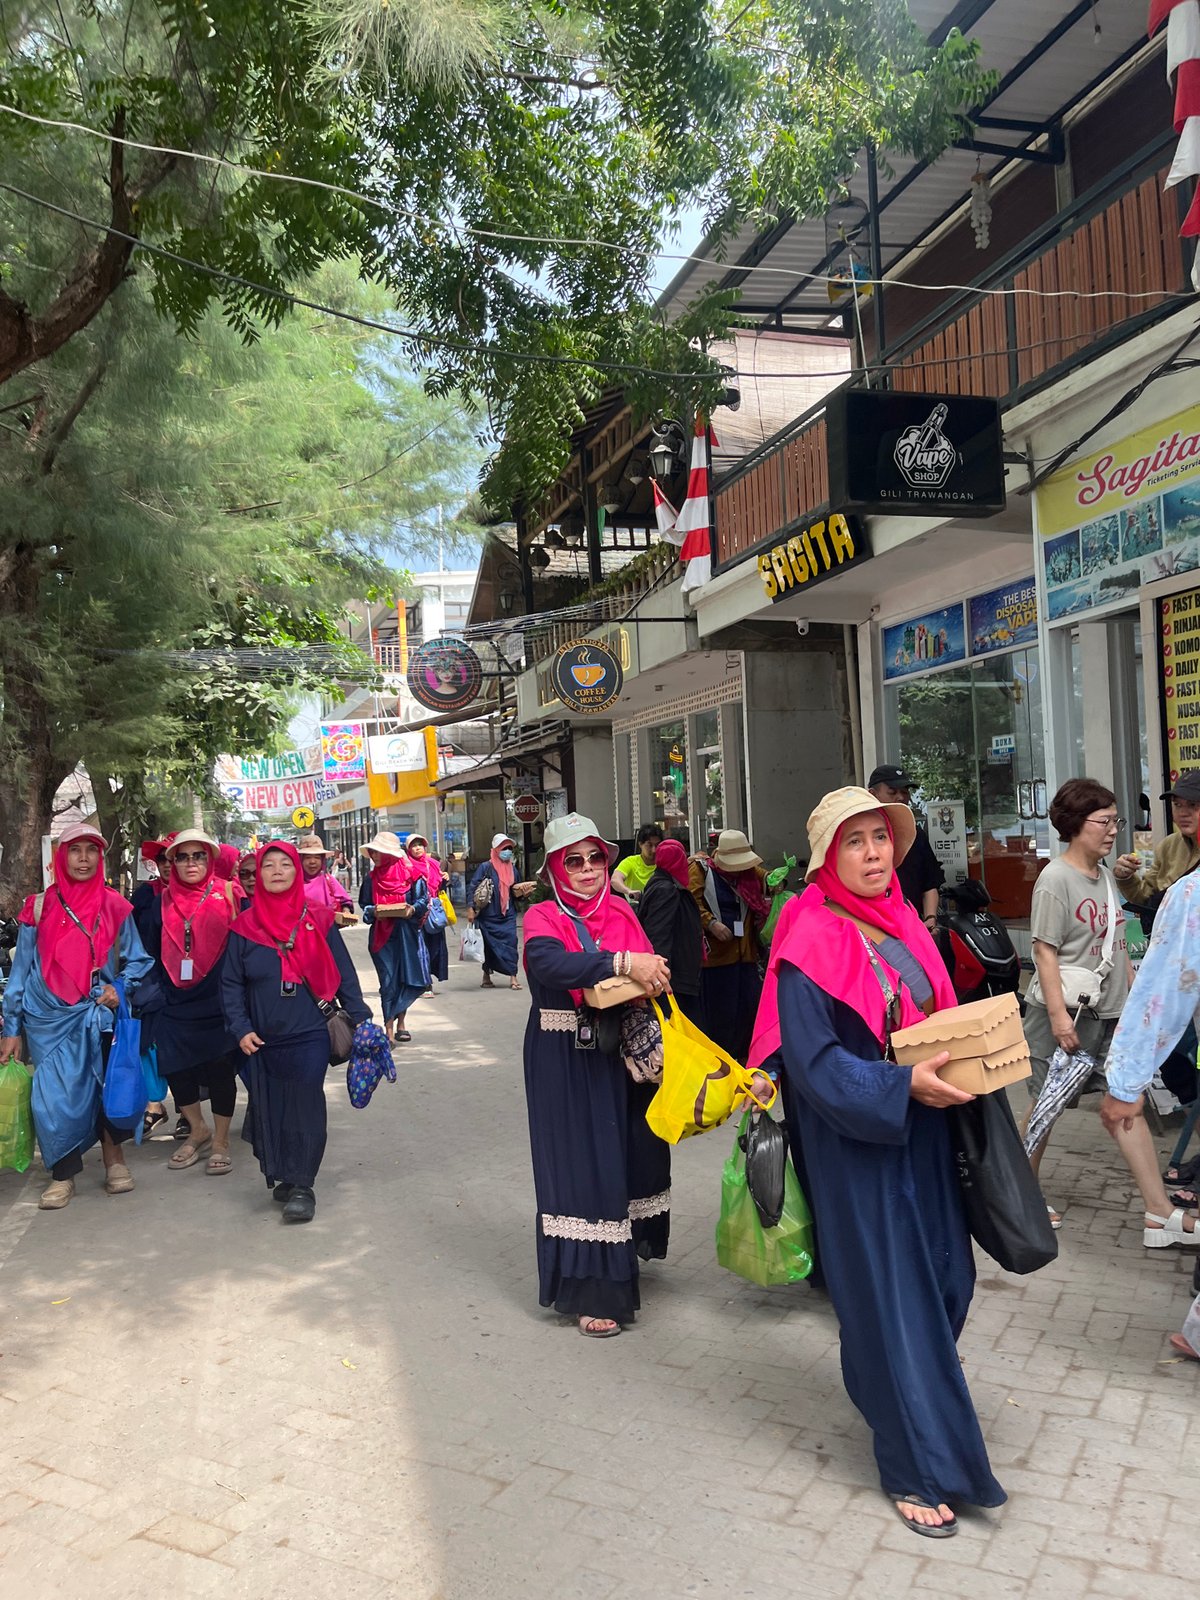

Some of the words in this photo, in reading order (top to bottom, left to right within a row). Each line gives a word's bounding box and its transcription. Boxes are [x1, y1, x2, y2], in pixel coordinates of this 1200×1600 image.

[900, 442, 953, 470] Vape
[914, 472, 940, 480] SHOP
[1147, 468, 1179, 486] Ticketing
[880, 490, 901, 498] GILI
[907, 490, 974, 500] TRAWANGAN
[757, 513, 855, 598] SAGITA
[1003, 592, 1020, 606] THE
[1021, 586, 1037, 600] BES
[1172, 595, 1193, 614] FAST
[996, 598, 1038, 620] DISPOSA
[1175, 658, 1199, 677] DAILY
[574, 688, 606, 697] COFFEE
[1176, 681, 1197, 698] FAST
[564, 697, 577, 708] GILI
[580, 696, 604, 704] HOUSE
[1178, 723, 1199, 740] FAST
[241, 758, 269, 780] NEW
[272, 752, 306, 778] OPEN
[246, 786, 278, 810] NEW
[283, 780, 317, 807] GYM
[316, 788, 336, 801] OPEN
[516, 804, 539, 813] COFFEE
[934, 840, 958, 850] IGET
[974, 912, 990, 922] AK
